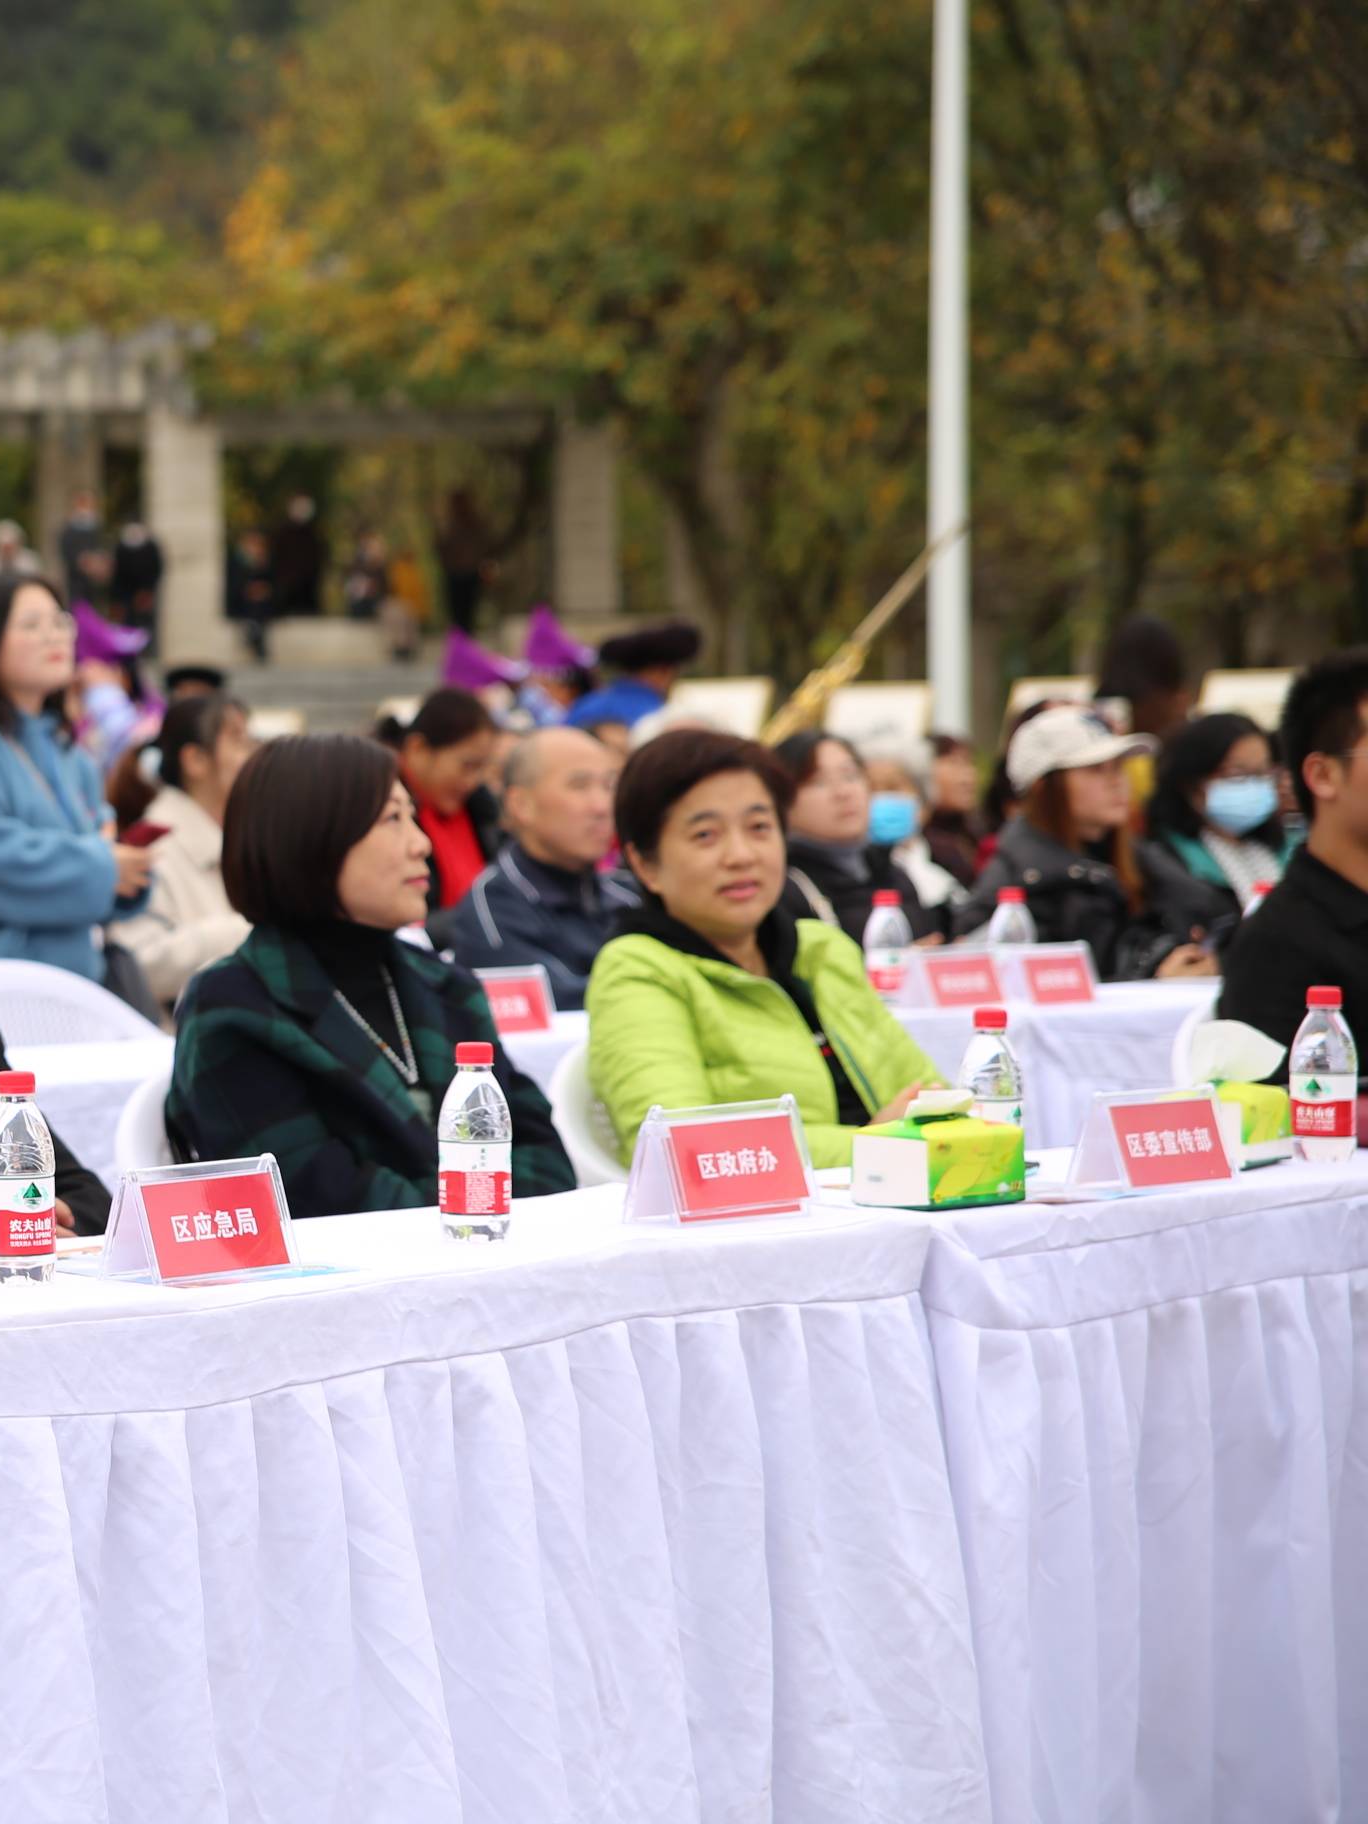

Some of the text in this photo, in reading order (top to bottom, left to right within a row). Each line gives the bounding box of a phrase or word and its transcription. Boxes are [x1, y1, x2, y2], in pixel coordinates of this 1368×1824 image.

[1125, 1126, 1213, 1158] 区委宣传部
[696, 1146, 779, 1180] 区政府办
[170, 1207, 259, 1243] 区应急局
